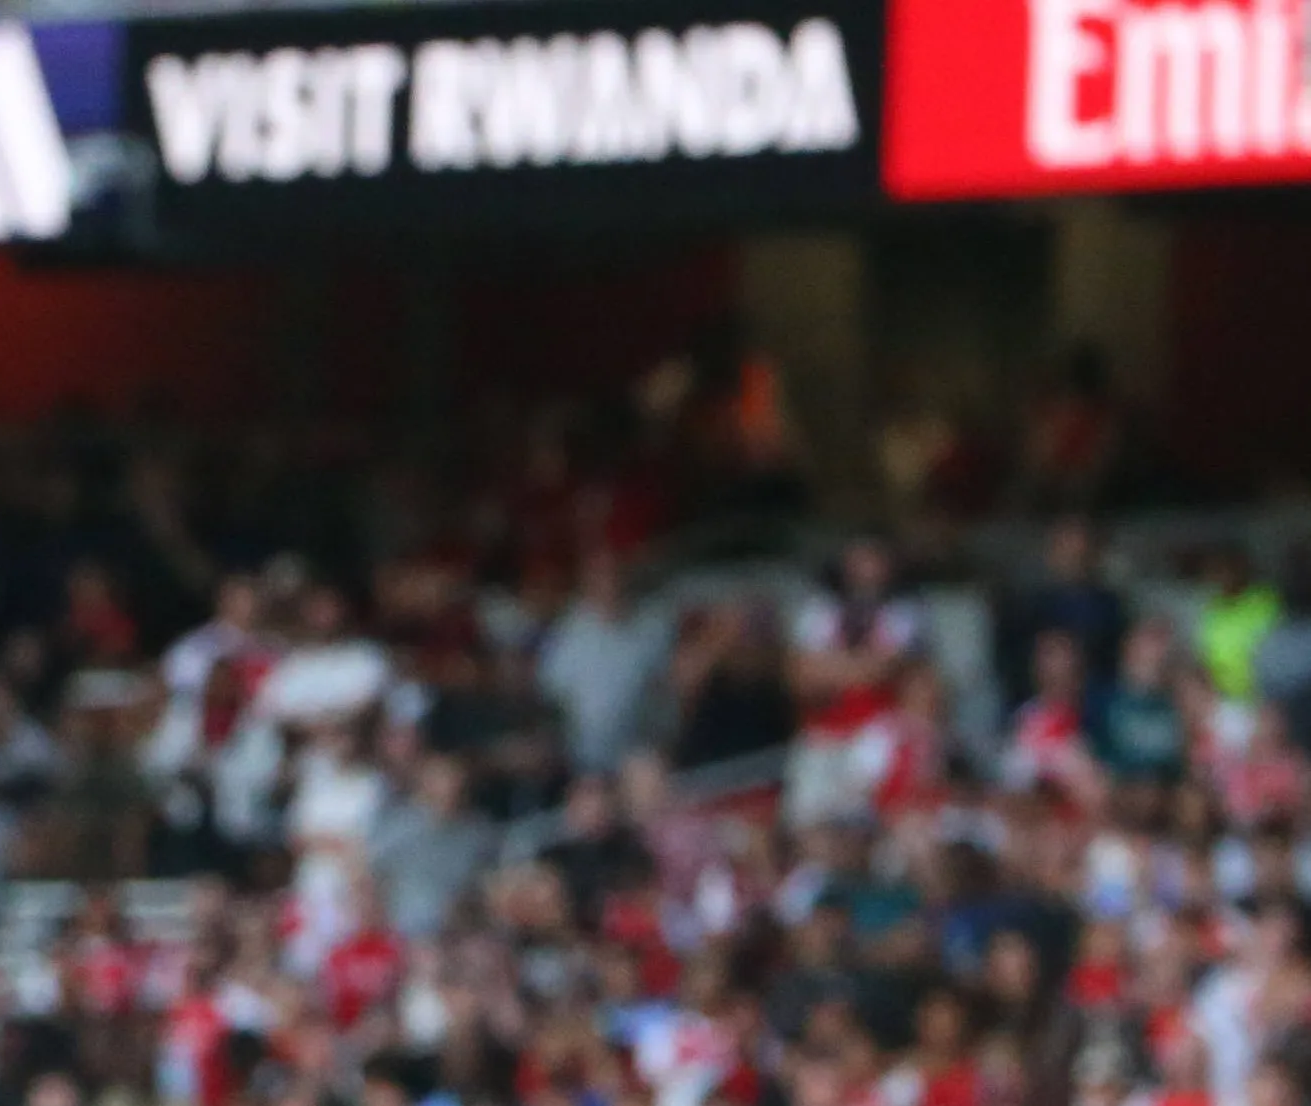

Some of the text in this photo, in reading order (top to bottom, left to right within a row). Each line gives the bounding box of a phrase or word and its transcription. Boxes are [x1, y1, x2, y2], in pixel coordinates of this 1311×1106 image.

[148, 20, 857, 181] VISIT RWANDA
[1026, 0, 1311, 167] Emi
